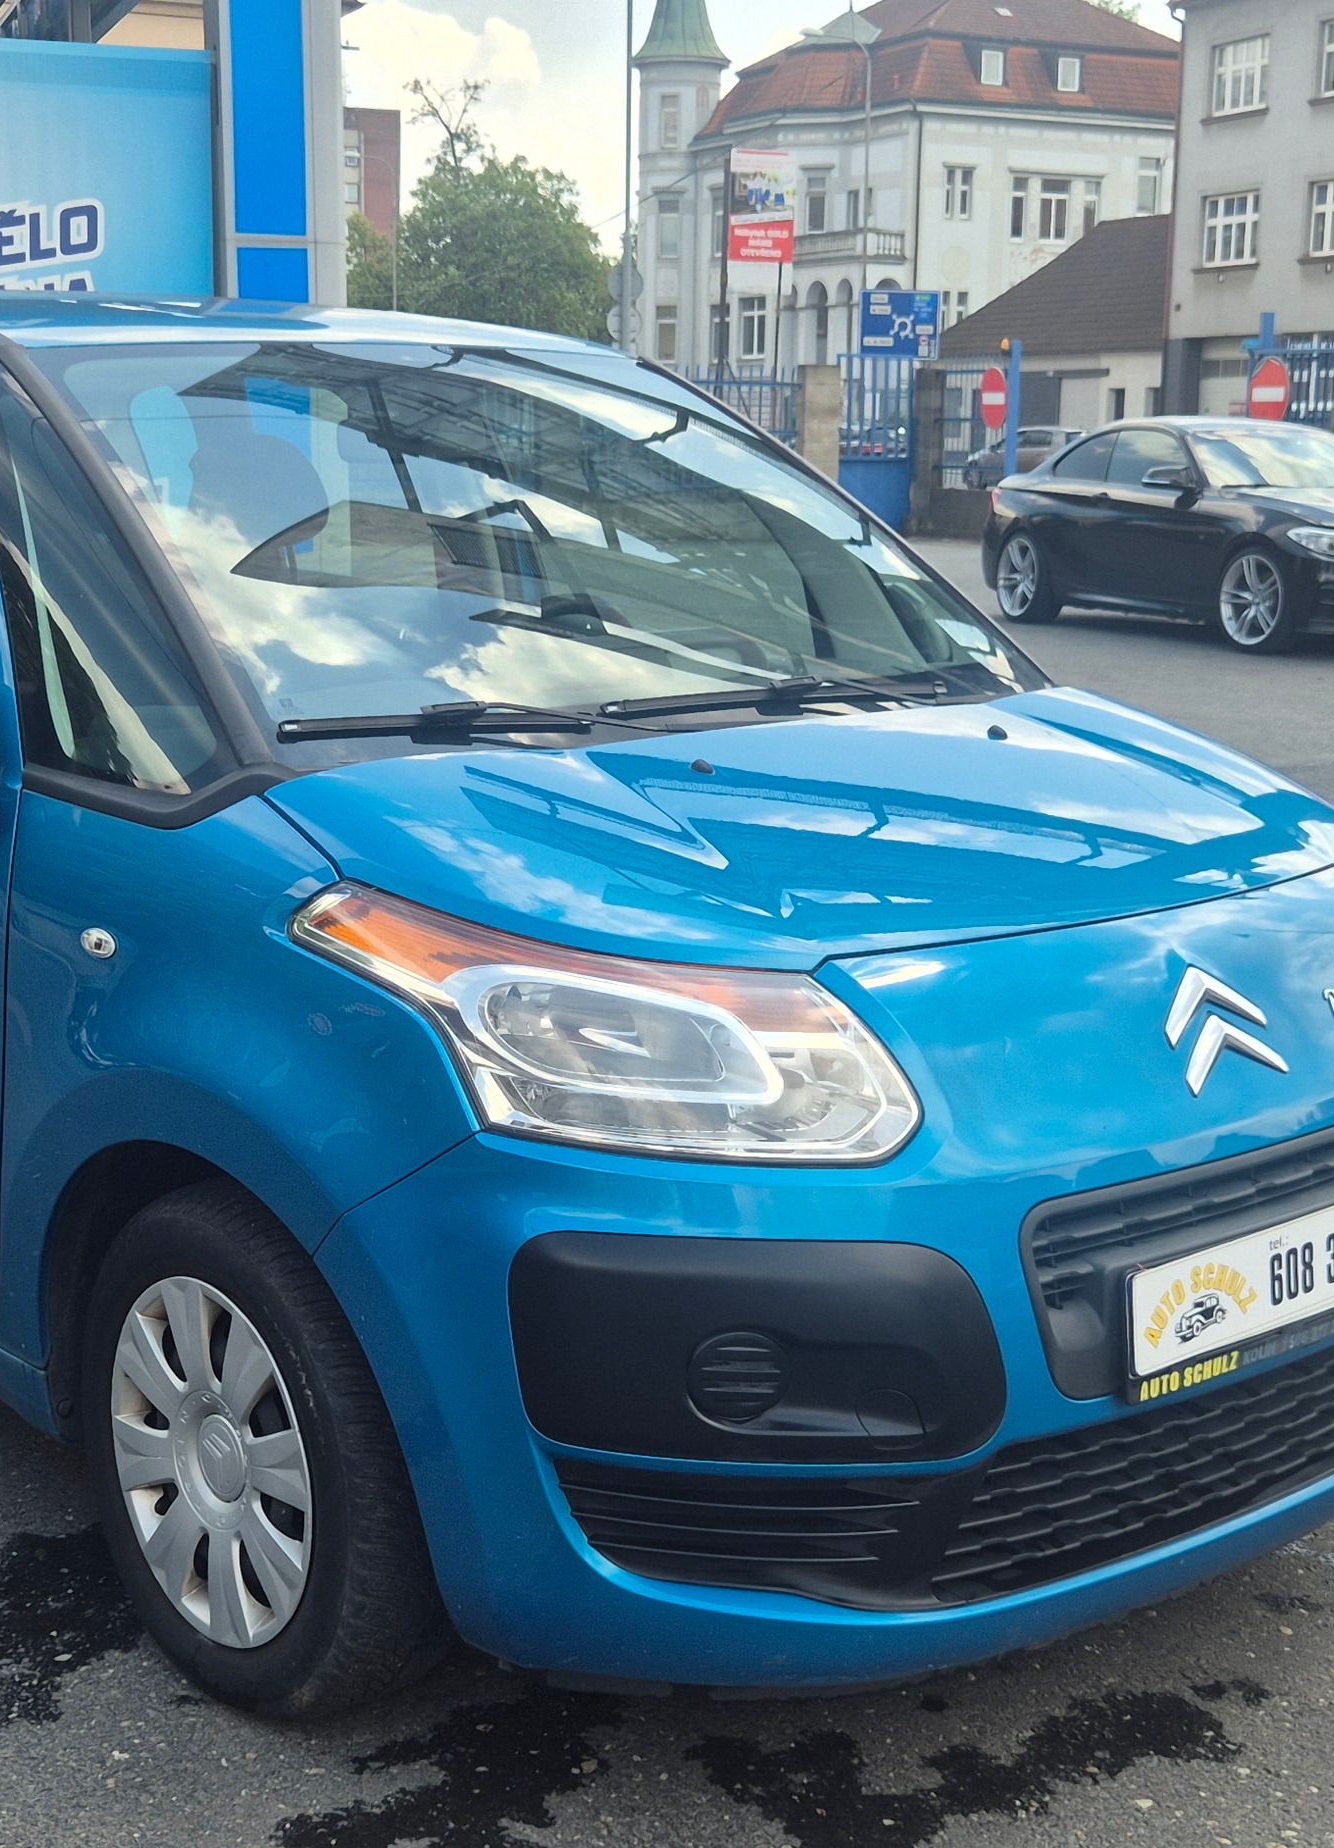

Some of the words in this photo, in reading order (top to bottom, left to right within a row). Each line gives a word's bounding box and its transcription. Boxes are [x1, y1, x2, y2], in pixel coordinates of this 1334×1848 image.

[1144, 1279, 1186, 1349] AUTO
[1190, 1263, 1258, 1314] SCHULZ
[1269, 1241, 1314, 1306] 608
[1140, 1371, 1180, 1401] AUTO
[1183, 1350, 1240, 1387] SCHULZ
